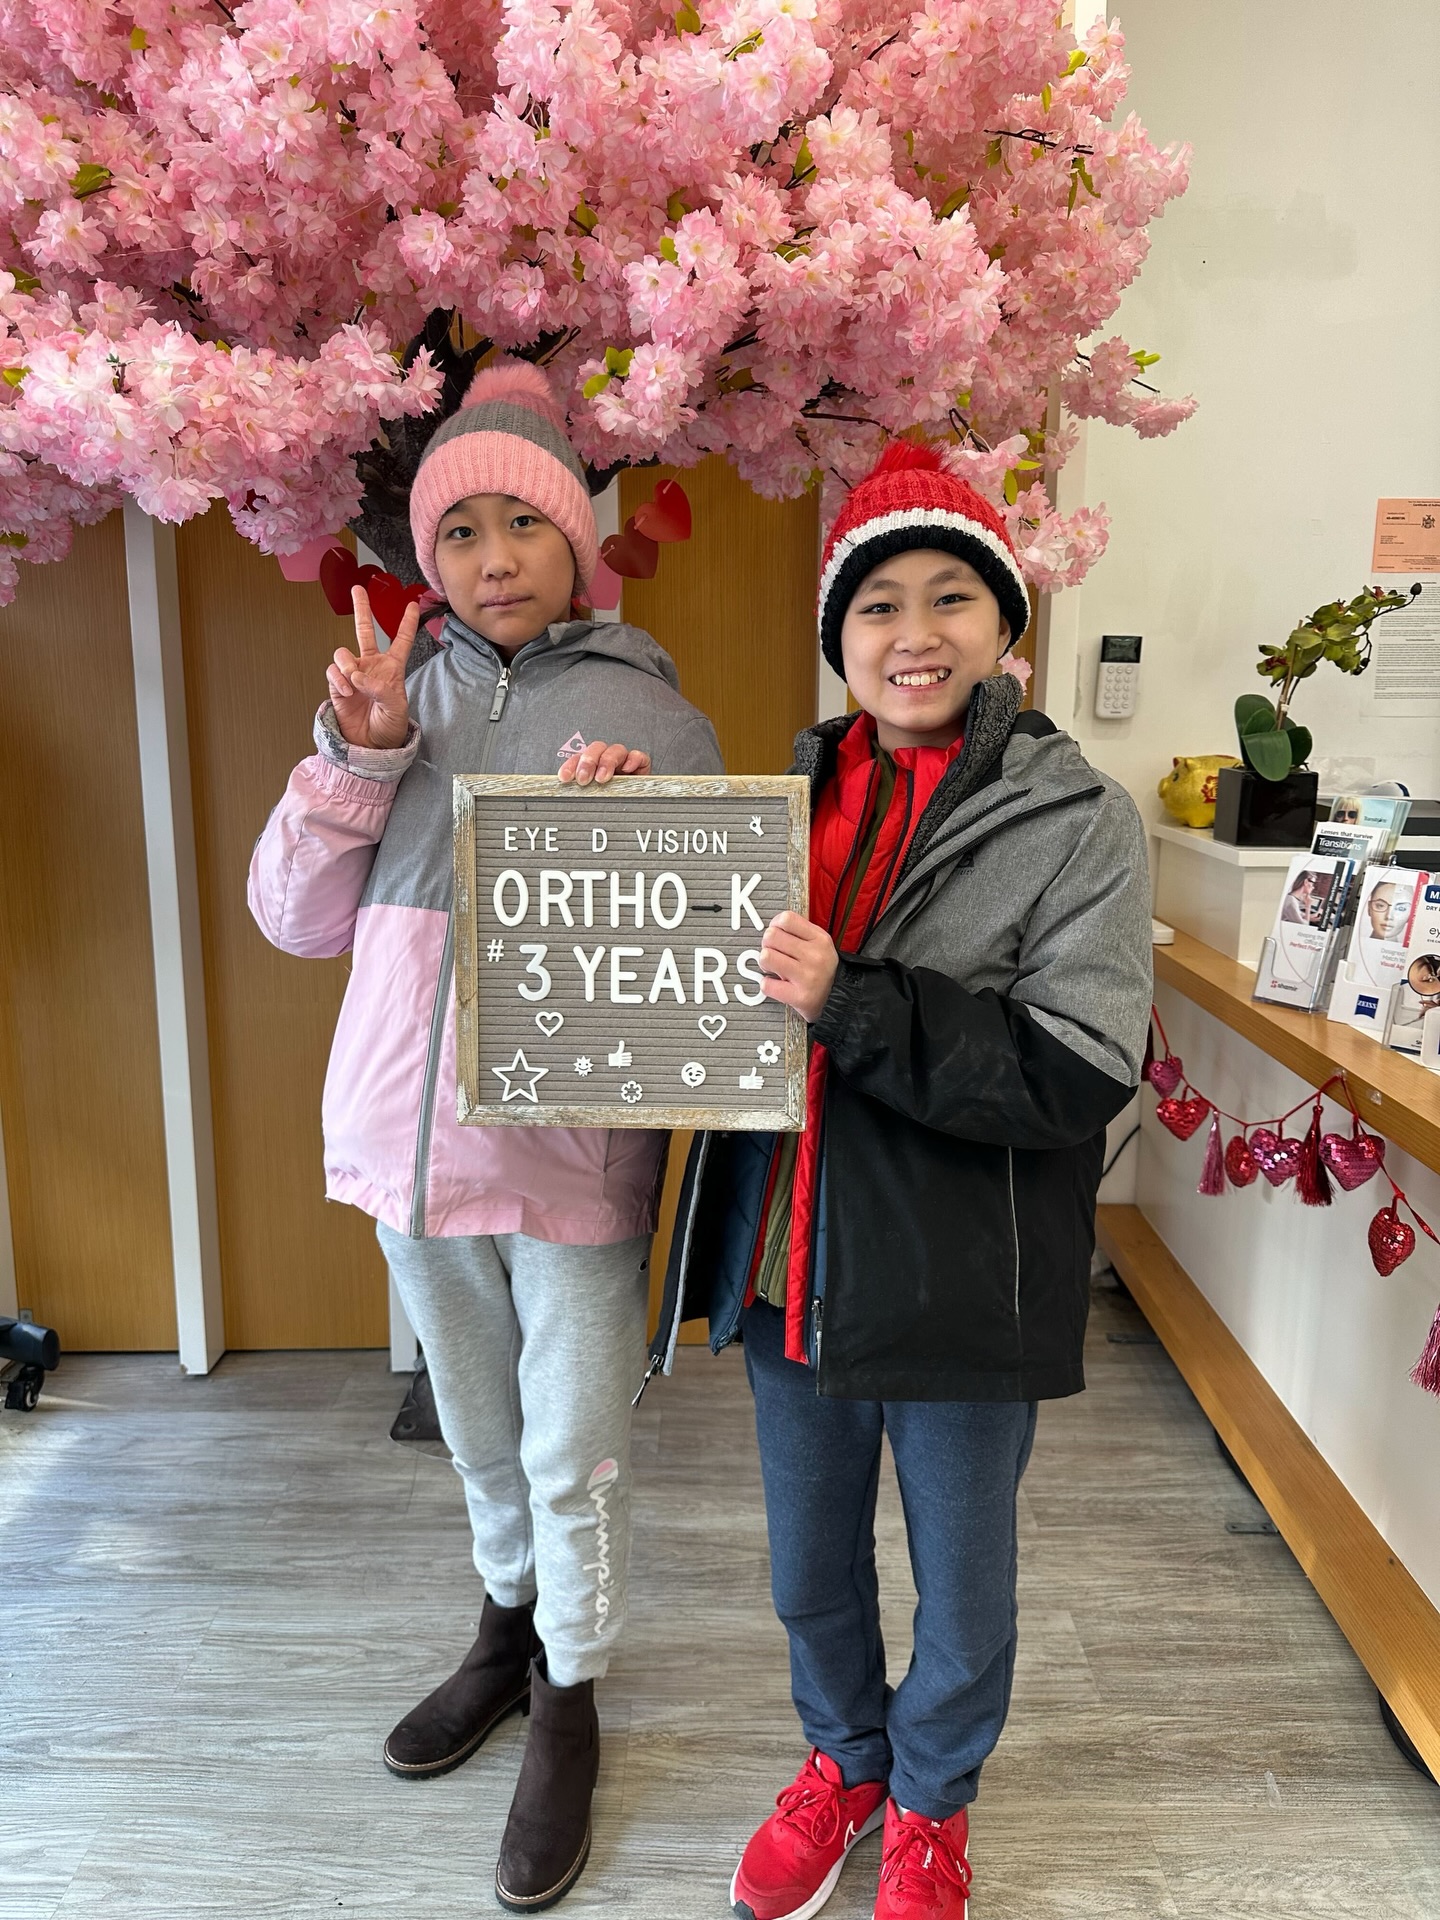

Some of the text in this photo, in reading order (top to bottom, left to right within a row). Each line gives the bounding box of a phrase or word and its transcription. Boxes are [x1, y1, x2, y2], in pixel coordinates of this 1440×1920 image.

[504, 826, 728, 855] EYE D VISION
[1319, 838, 1363, 851] Transitions
[493, 869, 766, 931] ORTHO K
[517, 944, 552, 1001] 3
[572, 946, 769, 1007] YEARS
[1357, 1000, 1377, 1010] ZEISS
[583, 1458, 619, 1634] Champion
